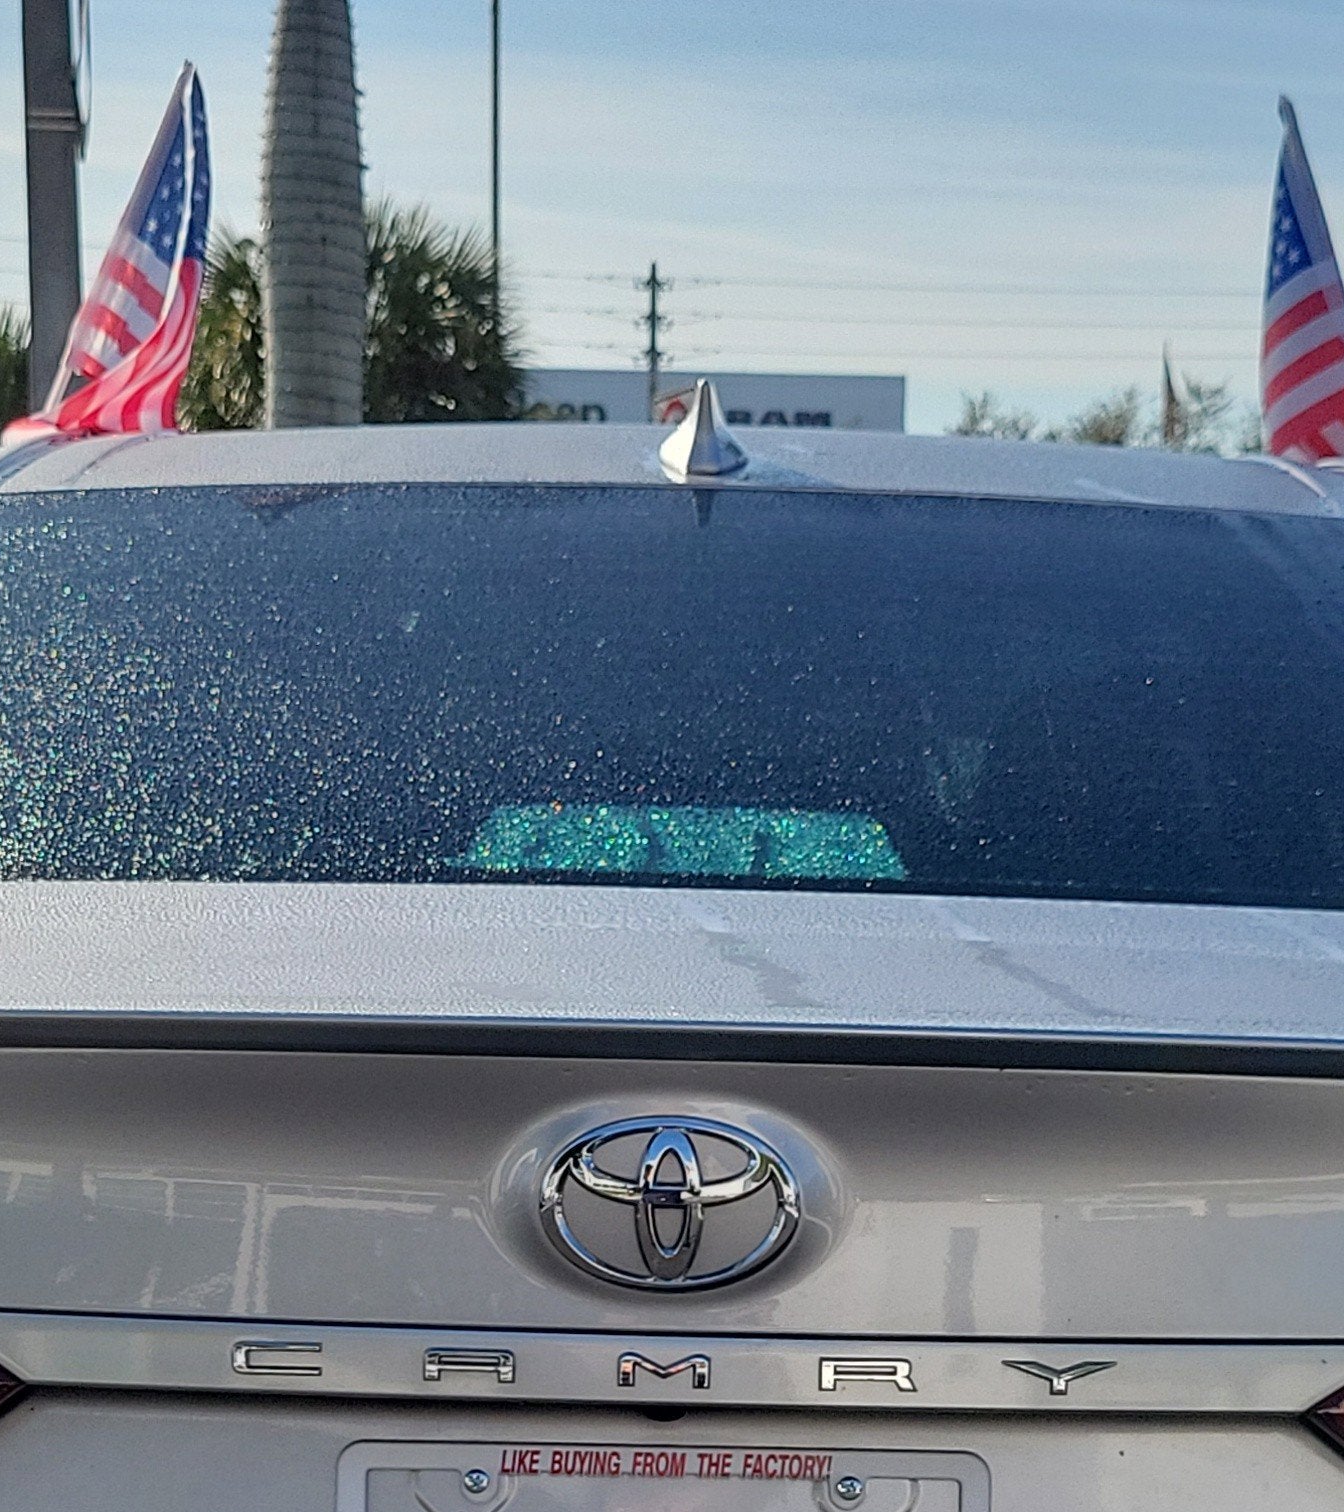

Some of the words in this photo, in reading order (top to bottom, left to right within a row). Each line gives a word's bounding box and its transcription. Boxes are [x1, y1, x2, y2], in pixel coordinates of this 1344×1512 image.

[726, 409, 831, 426] RAM
[231, 1340, 1118, 1395] CAMRY
[501, 1449, 540, 1474] LIKE
[550, 1450, 620, 1475] BUYING
[632, 1451, 686, 1477] FROM
[697, 1453, 732, 1477] THE
[742, 1453, 832, 1479] FACTORY!
